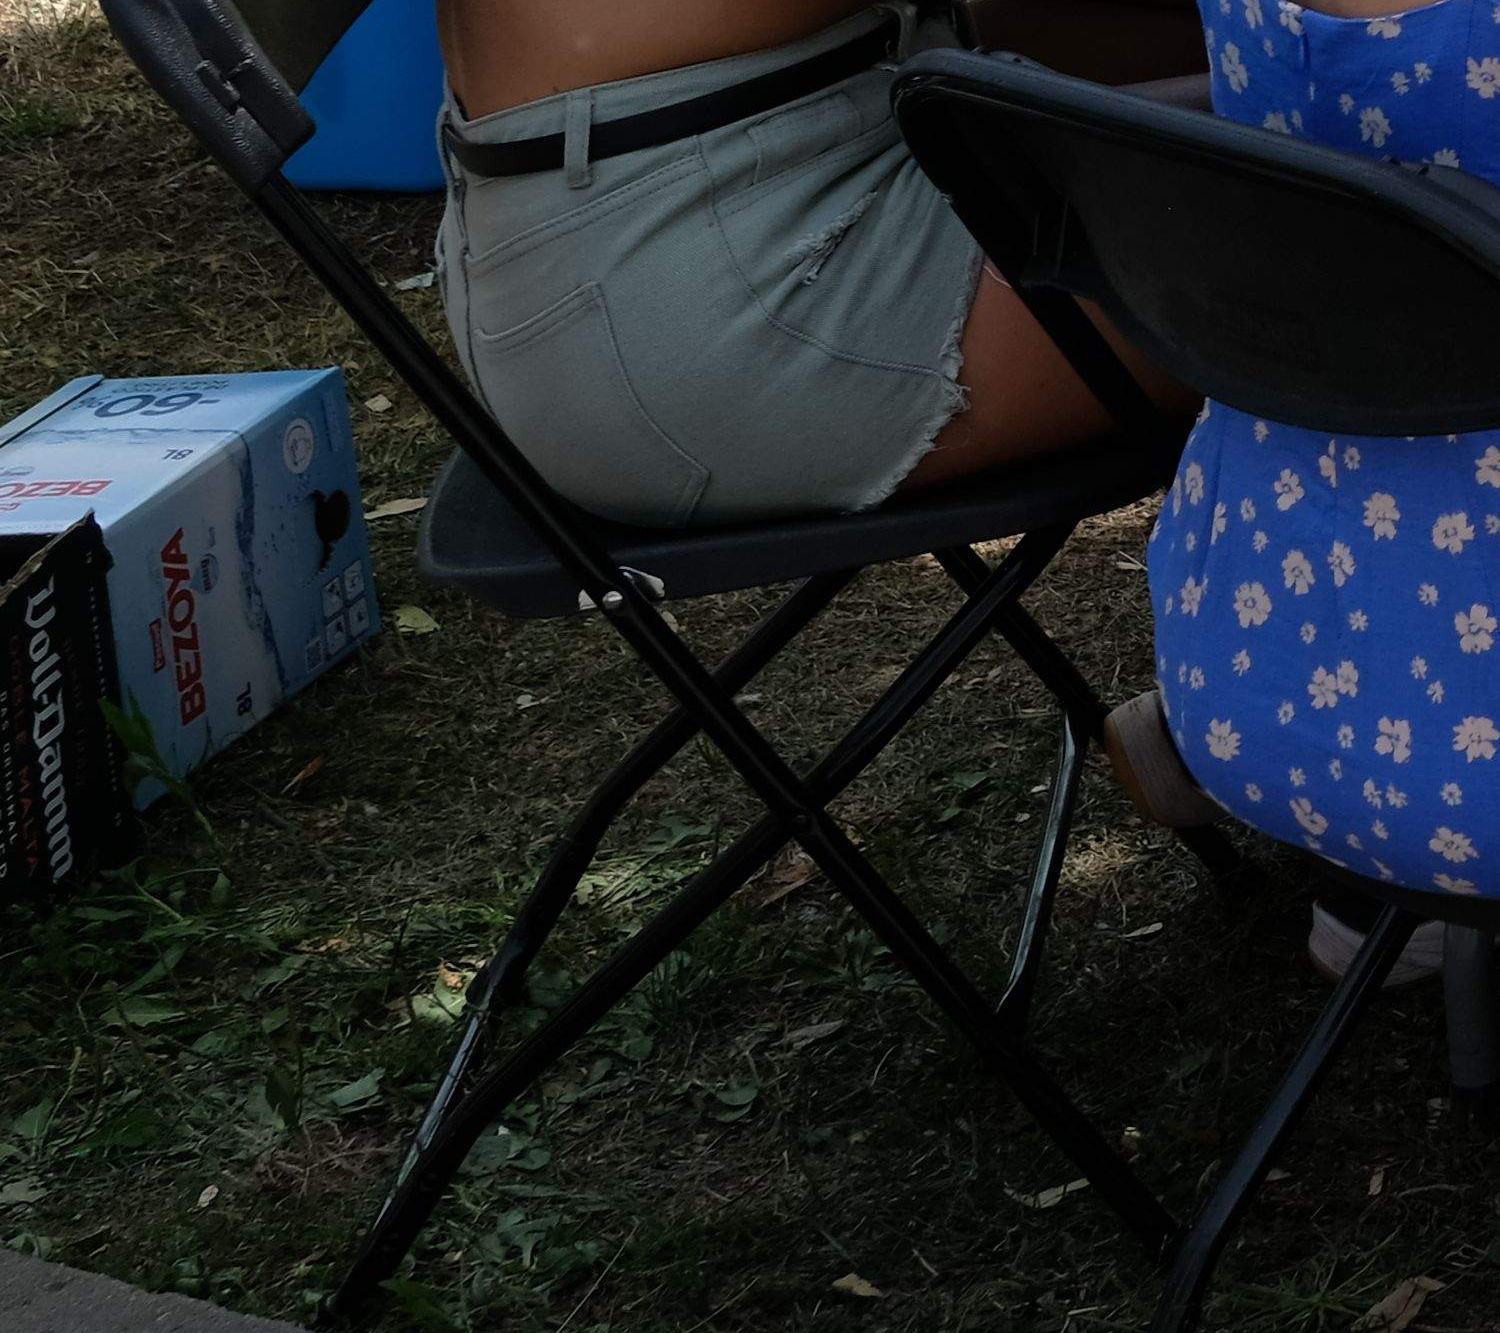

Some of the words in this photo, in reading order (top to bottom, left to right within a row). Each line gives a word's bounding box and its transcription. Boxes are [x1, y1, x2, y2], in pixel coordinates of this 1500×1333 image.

[160, 526, 209, 727] BEZOYA
[236, 681, 252, 717] 8L
[1, 742, 19, 847] ORIGINAL
[24, 575, 75, 885] Voll-Damm
